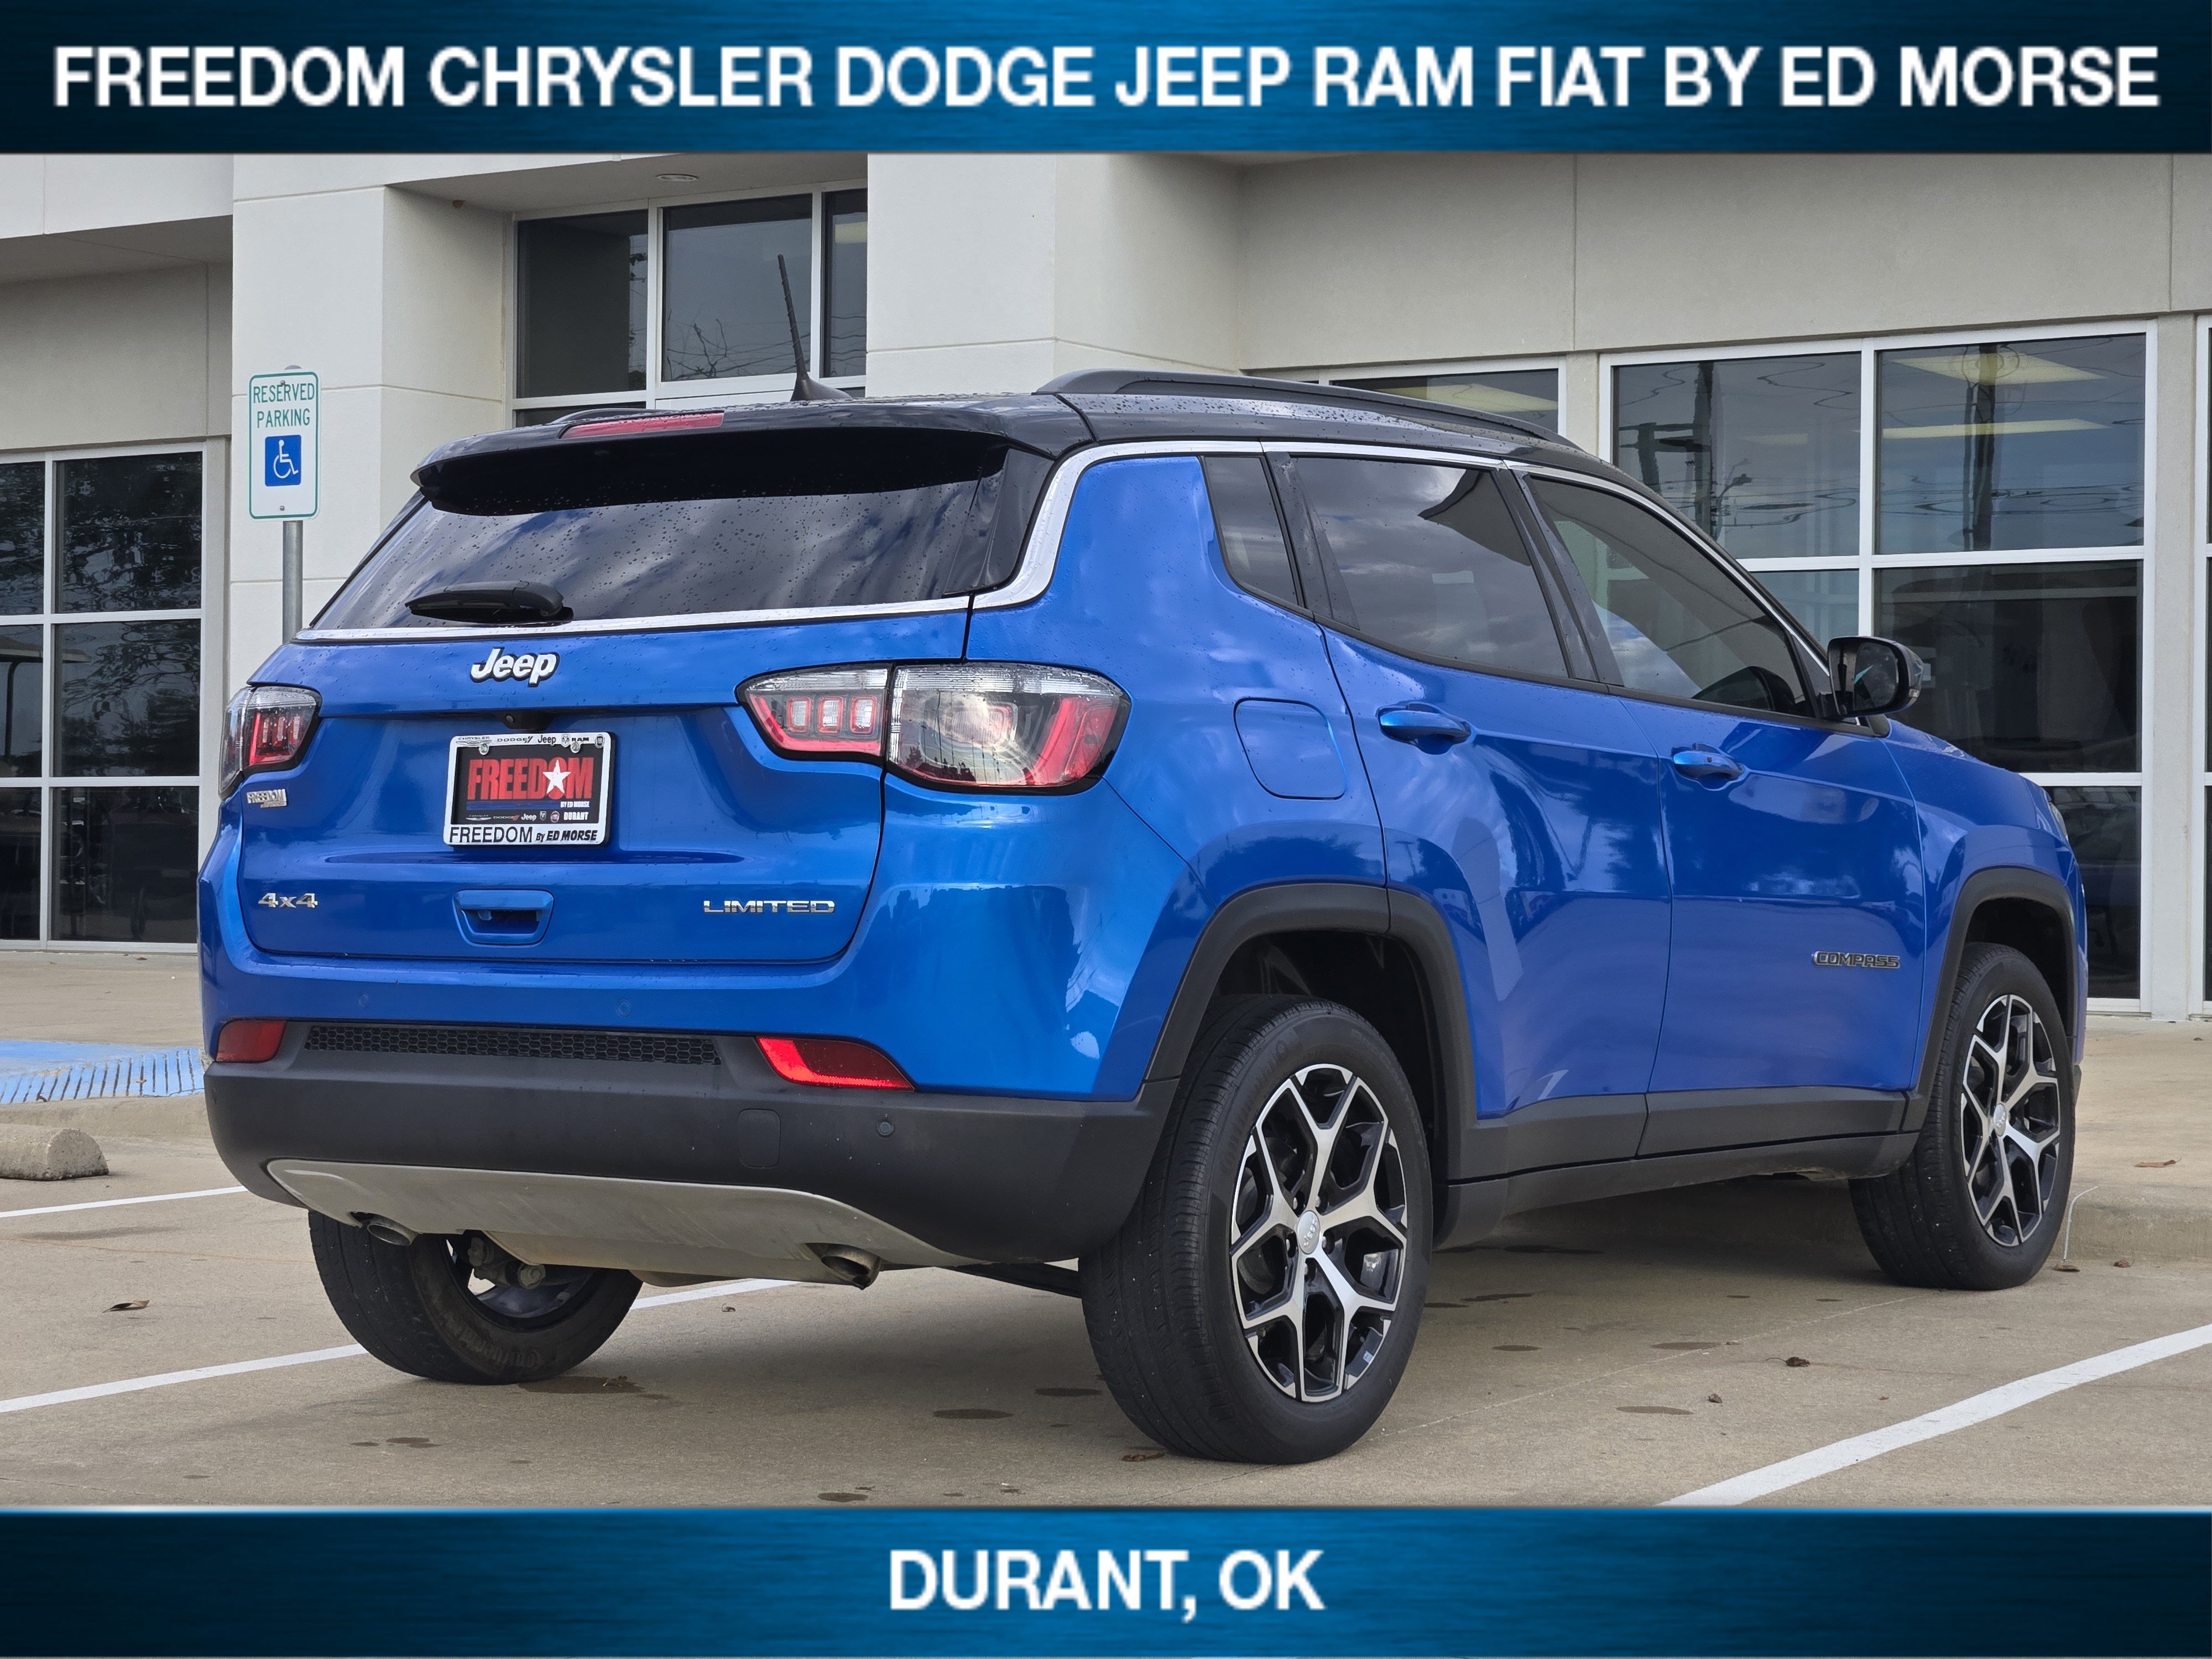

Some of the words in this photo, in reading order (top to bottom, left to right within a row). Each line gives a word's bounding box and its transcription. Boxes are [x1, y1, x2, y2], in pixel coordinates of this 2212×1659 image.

[253, 383, 315, 403] RESERVED
[257, 408, 310, 428] PARKING
[470, 648, 559, 686] Jeep
[538, 734, 556, 745] Jeep
[467, 757, 594, 800] FREEDOM
[521, 813, 537, 822] Jeep
[564, 811, 589, 821] DURANT
[449, 826, 533, 843] FREEDOM
[546, 830, 559, 841] ED
[561, 830, 598, 841] MORSE
[258, 893, 318, 908] 4x4
[703, 900, 835, 913] LIMITED
[1814, 951, 1900, 968] COMPASS
